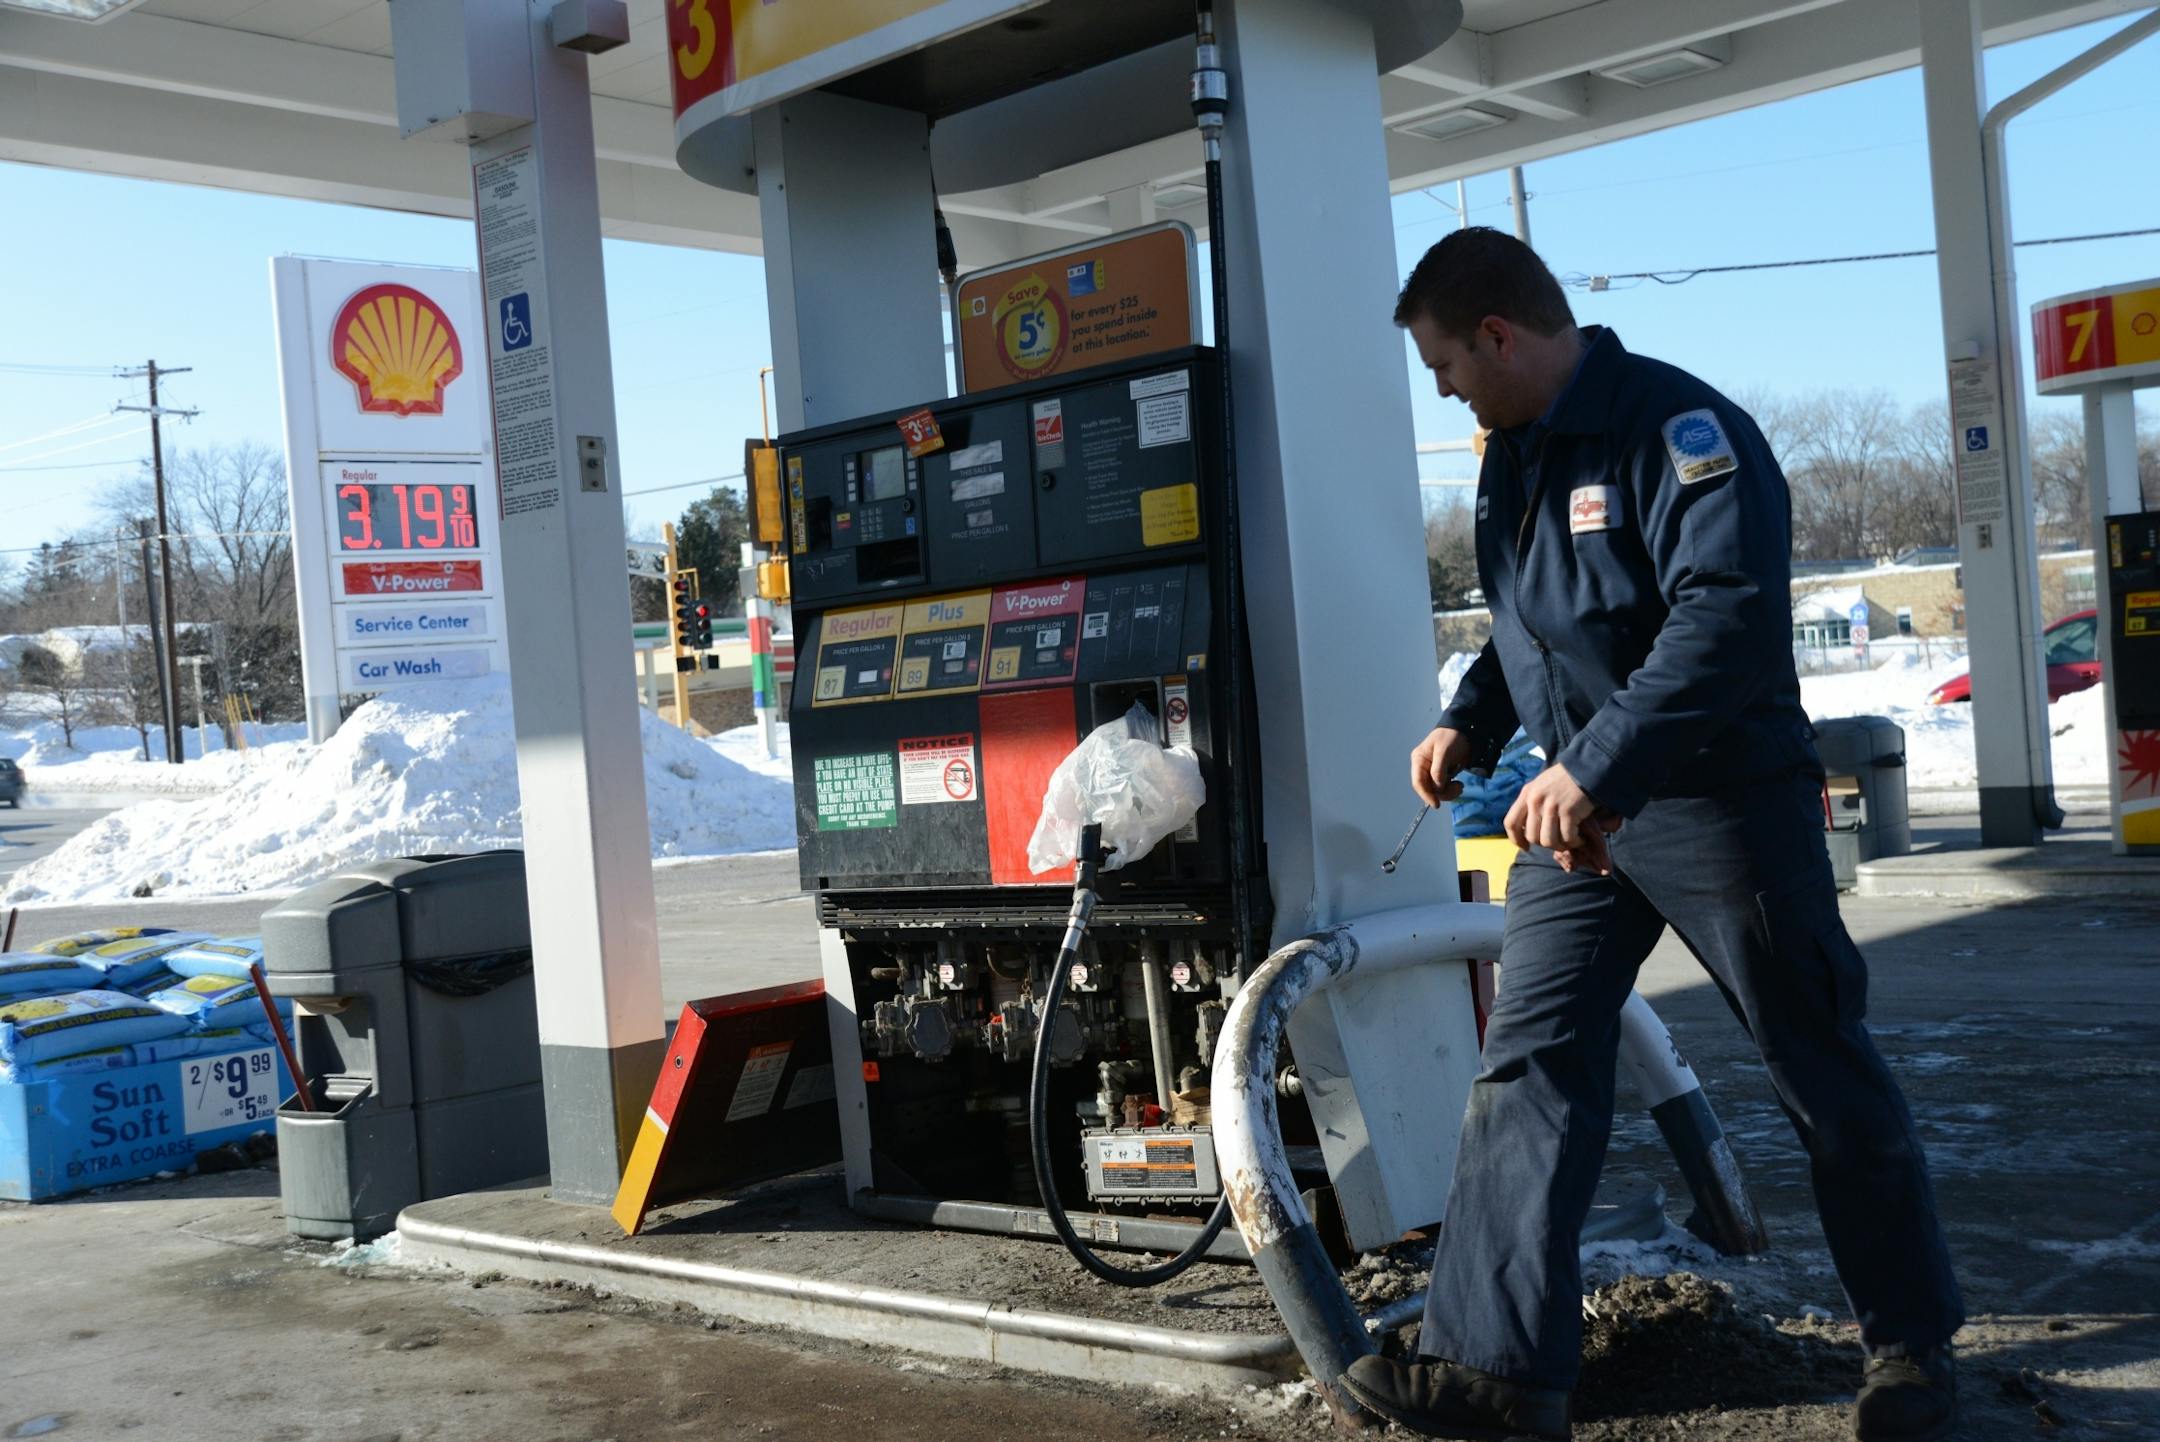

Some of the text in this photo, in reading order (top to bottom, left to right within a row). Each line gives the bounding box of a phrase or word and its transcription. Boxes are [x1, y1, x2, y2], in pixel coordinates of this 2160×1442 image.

[674, 0, 716, 80] 3
[1008, 285, 1040, 305] Save
[1071, 296, 1138, 320] for every $25
[1019, 308, 1045, 350] 5¢
[1072, 306, 1158, 340] you spend inside
[1072, 342, 1082, 352] at
[1086, 336, 1103, 350] this
[2065, 309, 2101, 363] 7
[1682, 426, 1712, 446] ASE
[342, 469, 377, 482] Regular
[340, 484, 445, 549] 3.19
[372, 574, 450, 591] V-Power
[1006, 593, 1065, 612] V-Power
[928, 603, 964, 622] Plus
[355, 615, 469, 633] Service Center
[830, 612, 894, 637] Regular
[1006, 625, 1023, 634] PRICE
[1036, 622, 1060, 630] GALLON
[915, 638, 930, 646] PRICE
[944, 634, 966, 642] GALLON
[832, 648, 848, 656] PRICE
[860, 644, 880, 652] GALLON
[359, 658, 442, 678] Car Wash
[996, 660, 1012, 675] 91
[908, 670, 922, 684] 89
[824, 678, 838, 695] 87
[902, 736, 968, 750] NOTICE
[814, 760, 824, 770] DUE
[825, 759, 832, 770] TO
[832, 757, 855, 769] INCREASE
[856, 756, 862, 767] IN
[862, 754, 876, 766] DRIVE
[816, 771, 821, 781] IF
[822, 770, 832, 781] YOU
[833, 769, 847, 780] HAVE
[848, 768, 856, 778] AN
[857, 767, 867, 778] OUT
[868, 766, 875, 777] OF
[816, 781, 833, 792] PLATE
[834, 780, 842, 792] OR
[844, 780, 851, 790] NO
[852, 778, 872, 790] VISIBLE
[818, 788, 895, 804] YOU MUST PREPAY OR USE YOUR
[818, 804, 838, 815] CREDIT
[839, 803, 854, 813] CARD
[856, 802, 863, 812] AT
[864, 801, 876, 812] THE
[60, 1015, 96, 1028] EXTRA
[92, 1080, 166, 1114] Sun
[90, 1108, 170, 1149] Soft
[66, 1138, 196, 1178] EXTRA COARSE
